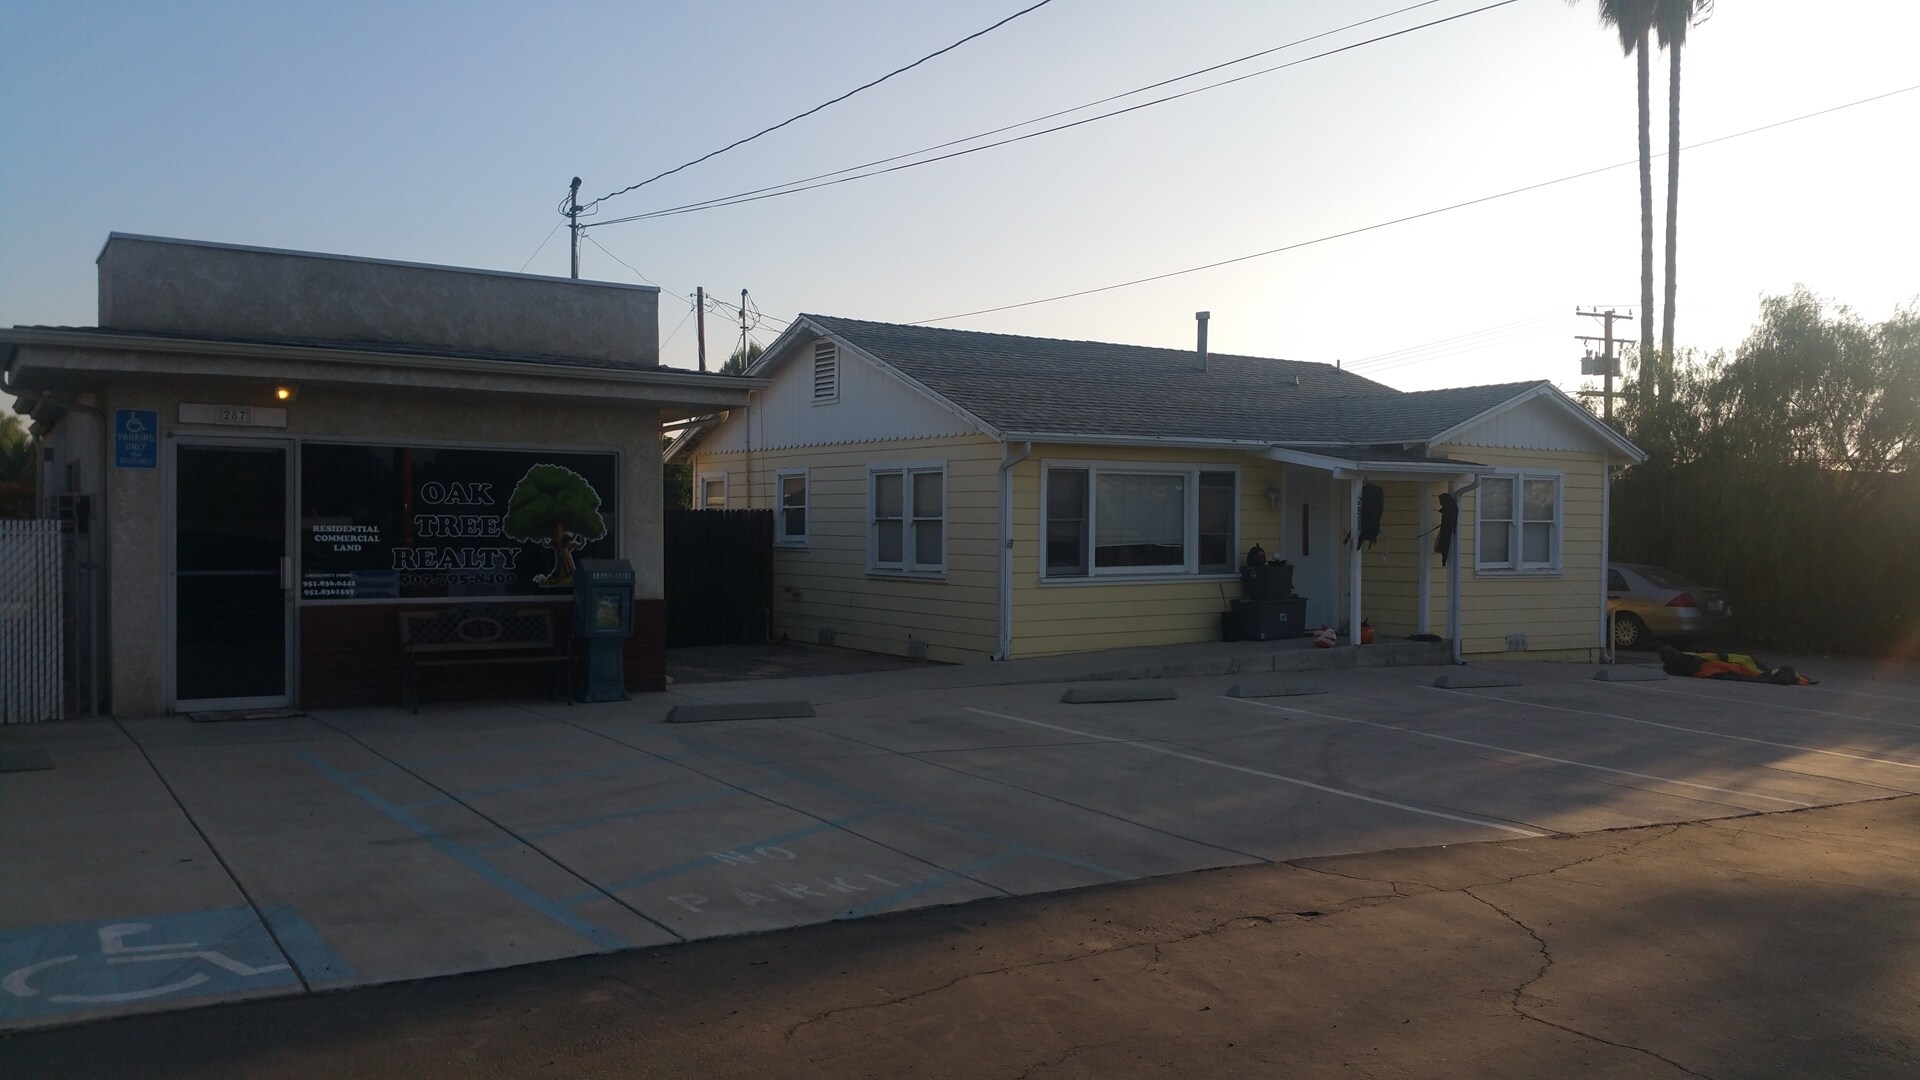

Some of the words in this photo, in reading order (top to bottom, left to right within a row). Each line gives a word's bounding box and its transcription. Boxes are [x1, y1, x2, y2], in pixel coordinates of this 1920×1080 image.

[224, 409, 246, 421] 287
[117, 432, 155, 442] PARKING
[125, 442, 147, 450] ONLY
[420, 481, 495, 505] OAK
[312, 524, 380, 533] RESIDENTIAL
[414, 514, 502, 537] TREE
[314, 534, 381, 543] COMMERCIAL
[333, 544, 362, 552] LAND
[391, 547, 523, 570] REALTY
[709, 845, 797, 866] NO
